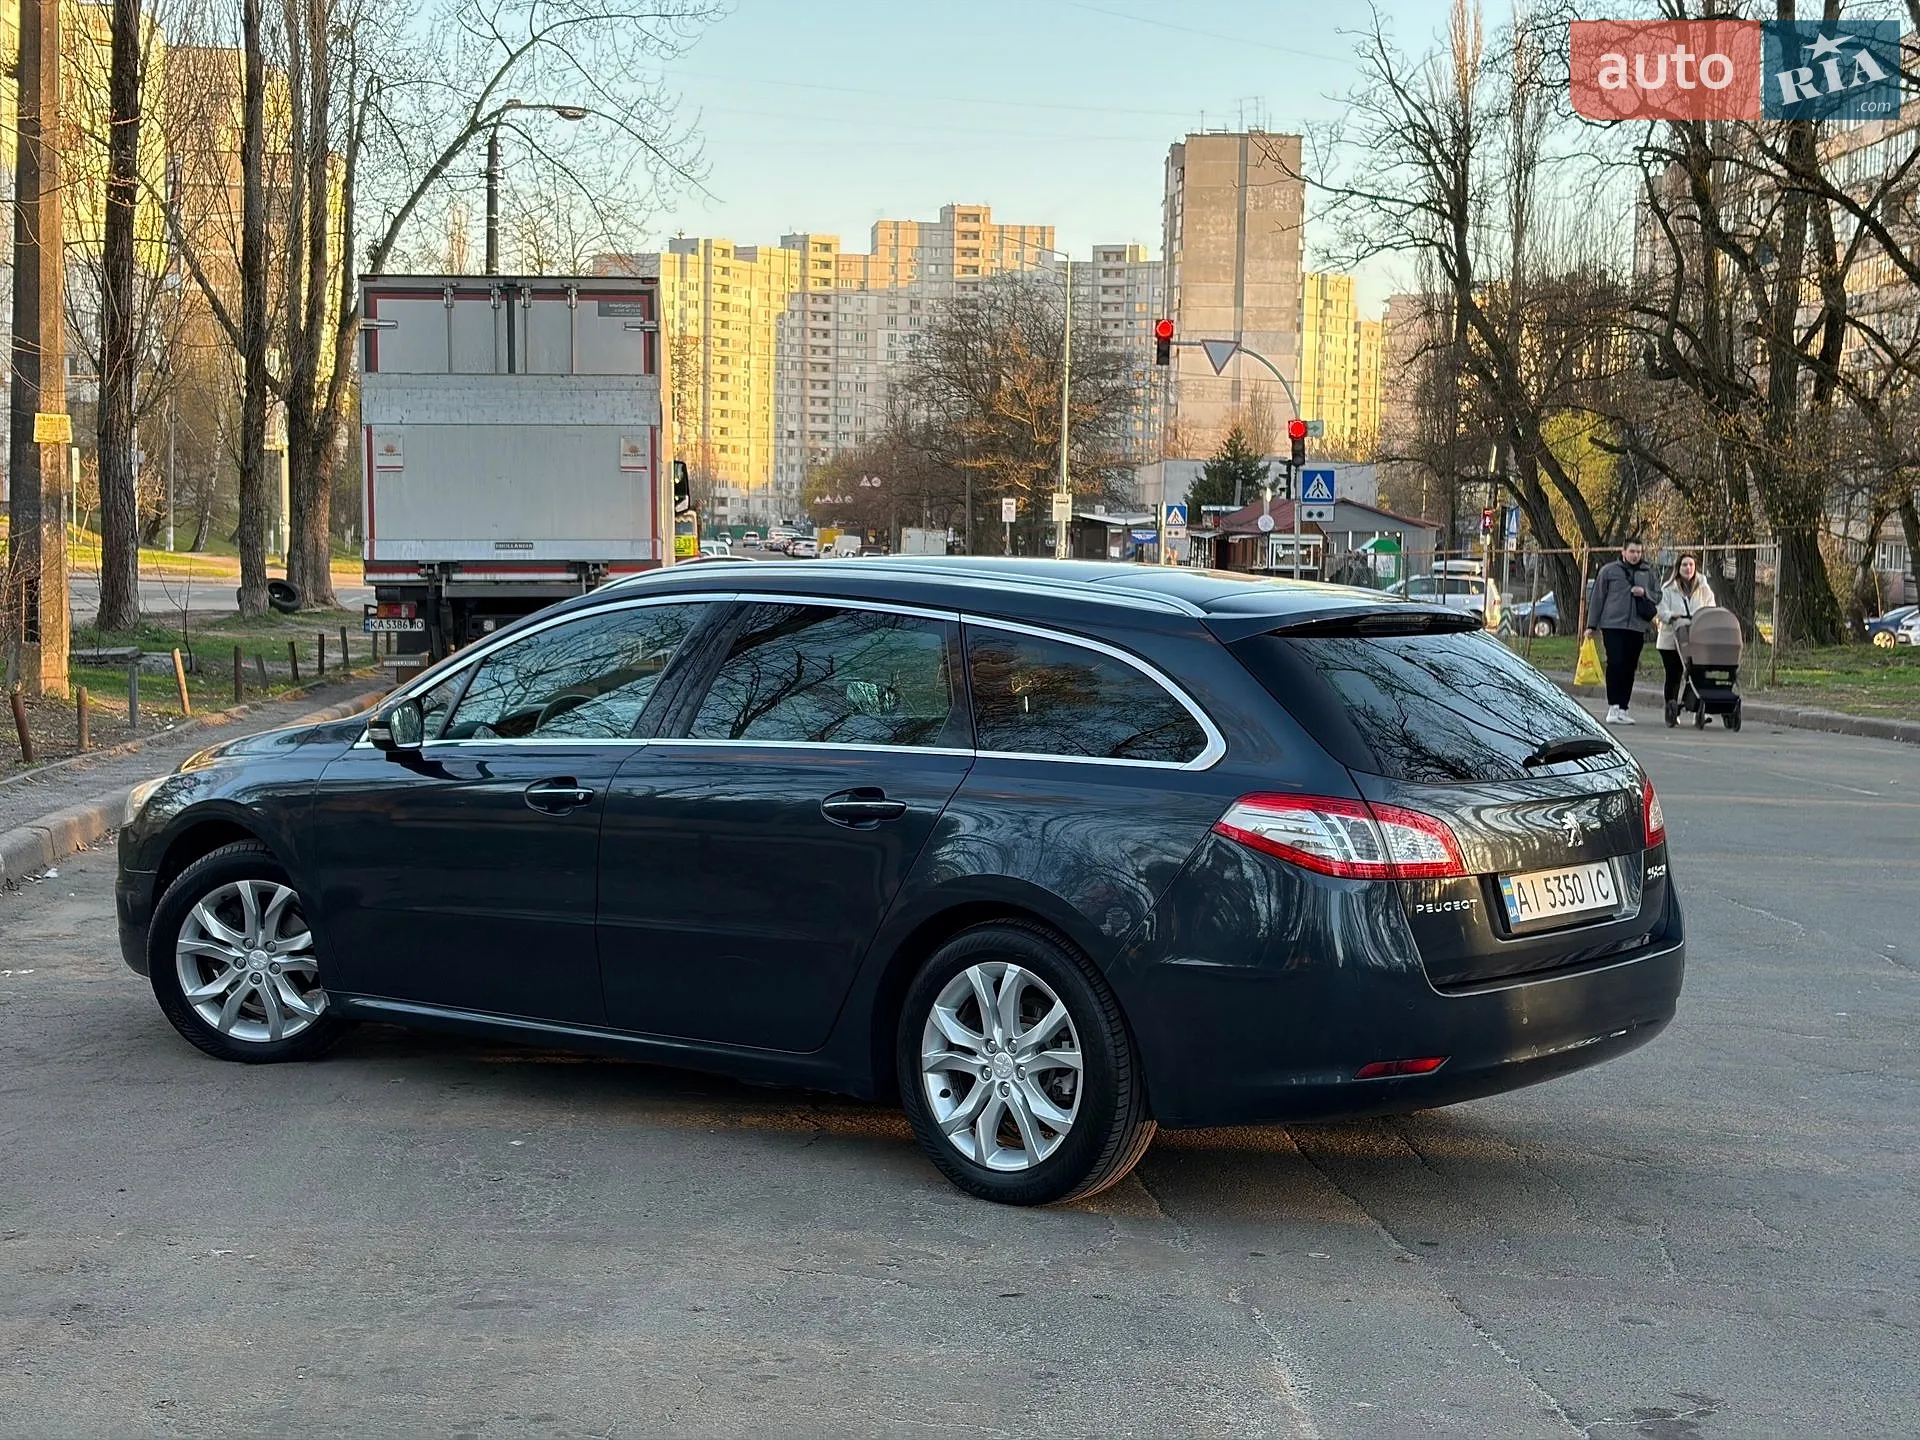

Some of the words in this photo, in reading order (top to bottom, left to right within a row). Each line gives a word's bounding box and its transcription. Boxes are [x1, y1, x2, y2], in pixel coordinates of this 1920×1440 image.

[370, 620, 384, 629] KA
[386, 620, 408, 629] 5386
[1543, 873, 1585, 908] 5350
[1587, 868, 1609, 902] IC
[1416, 899, 1478, 914] PEUGEOT
